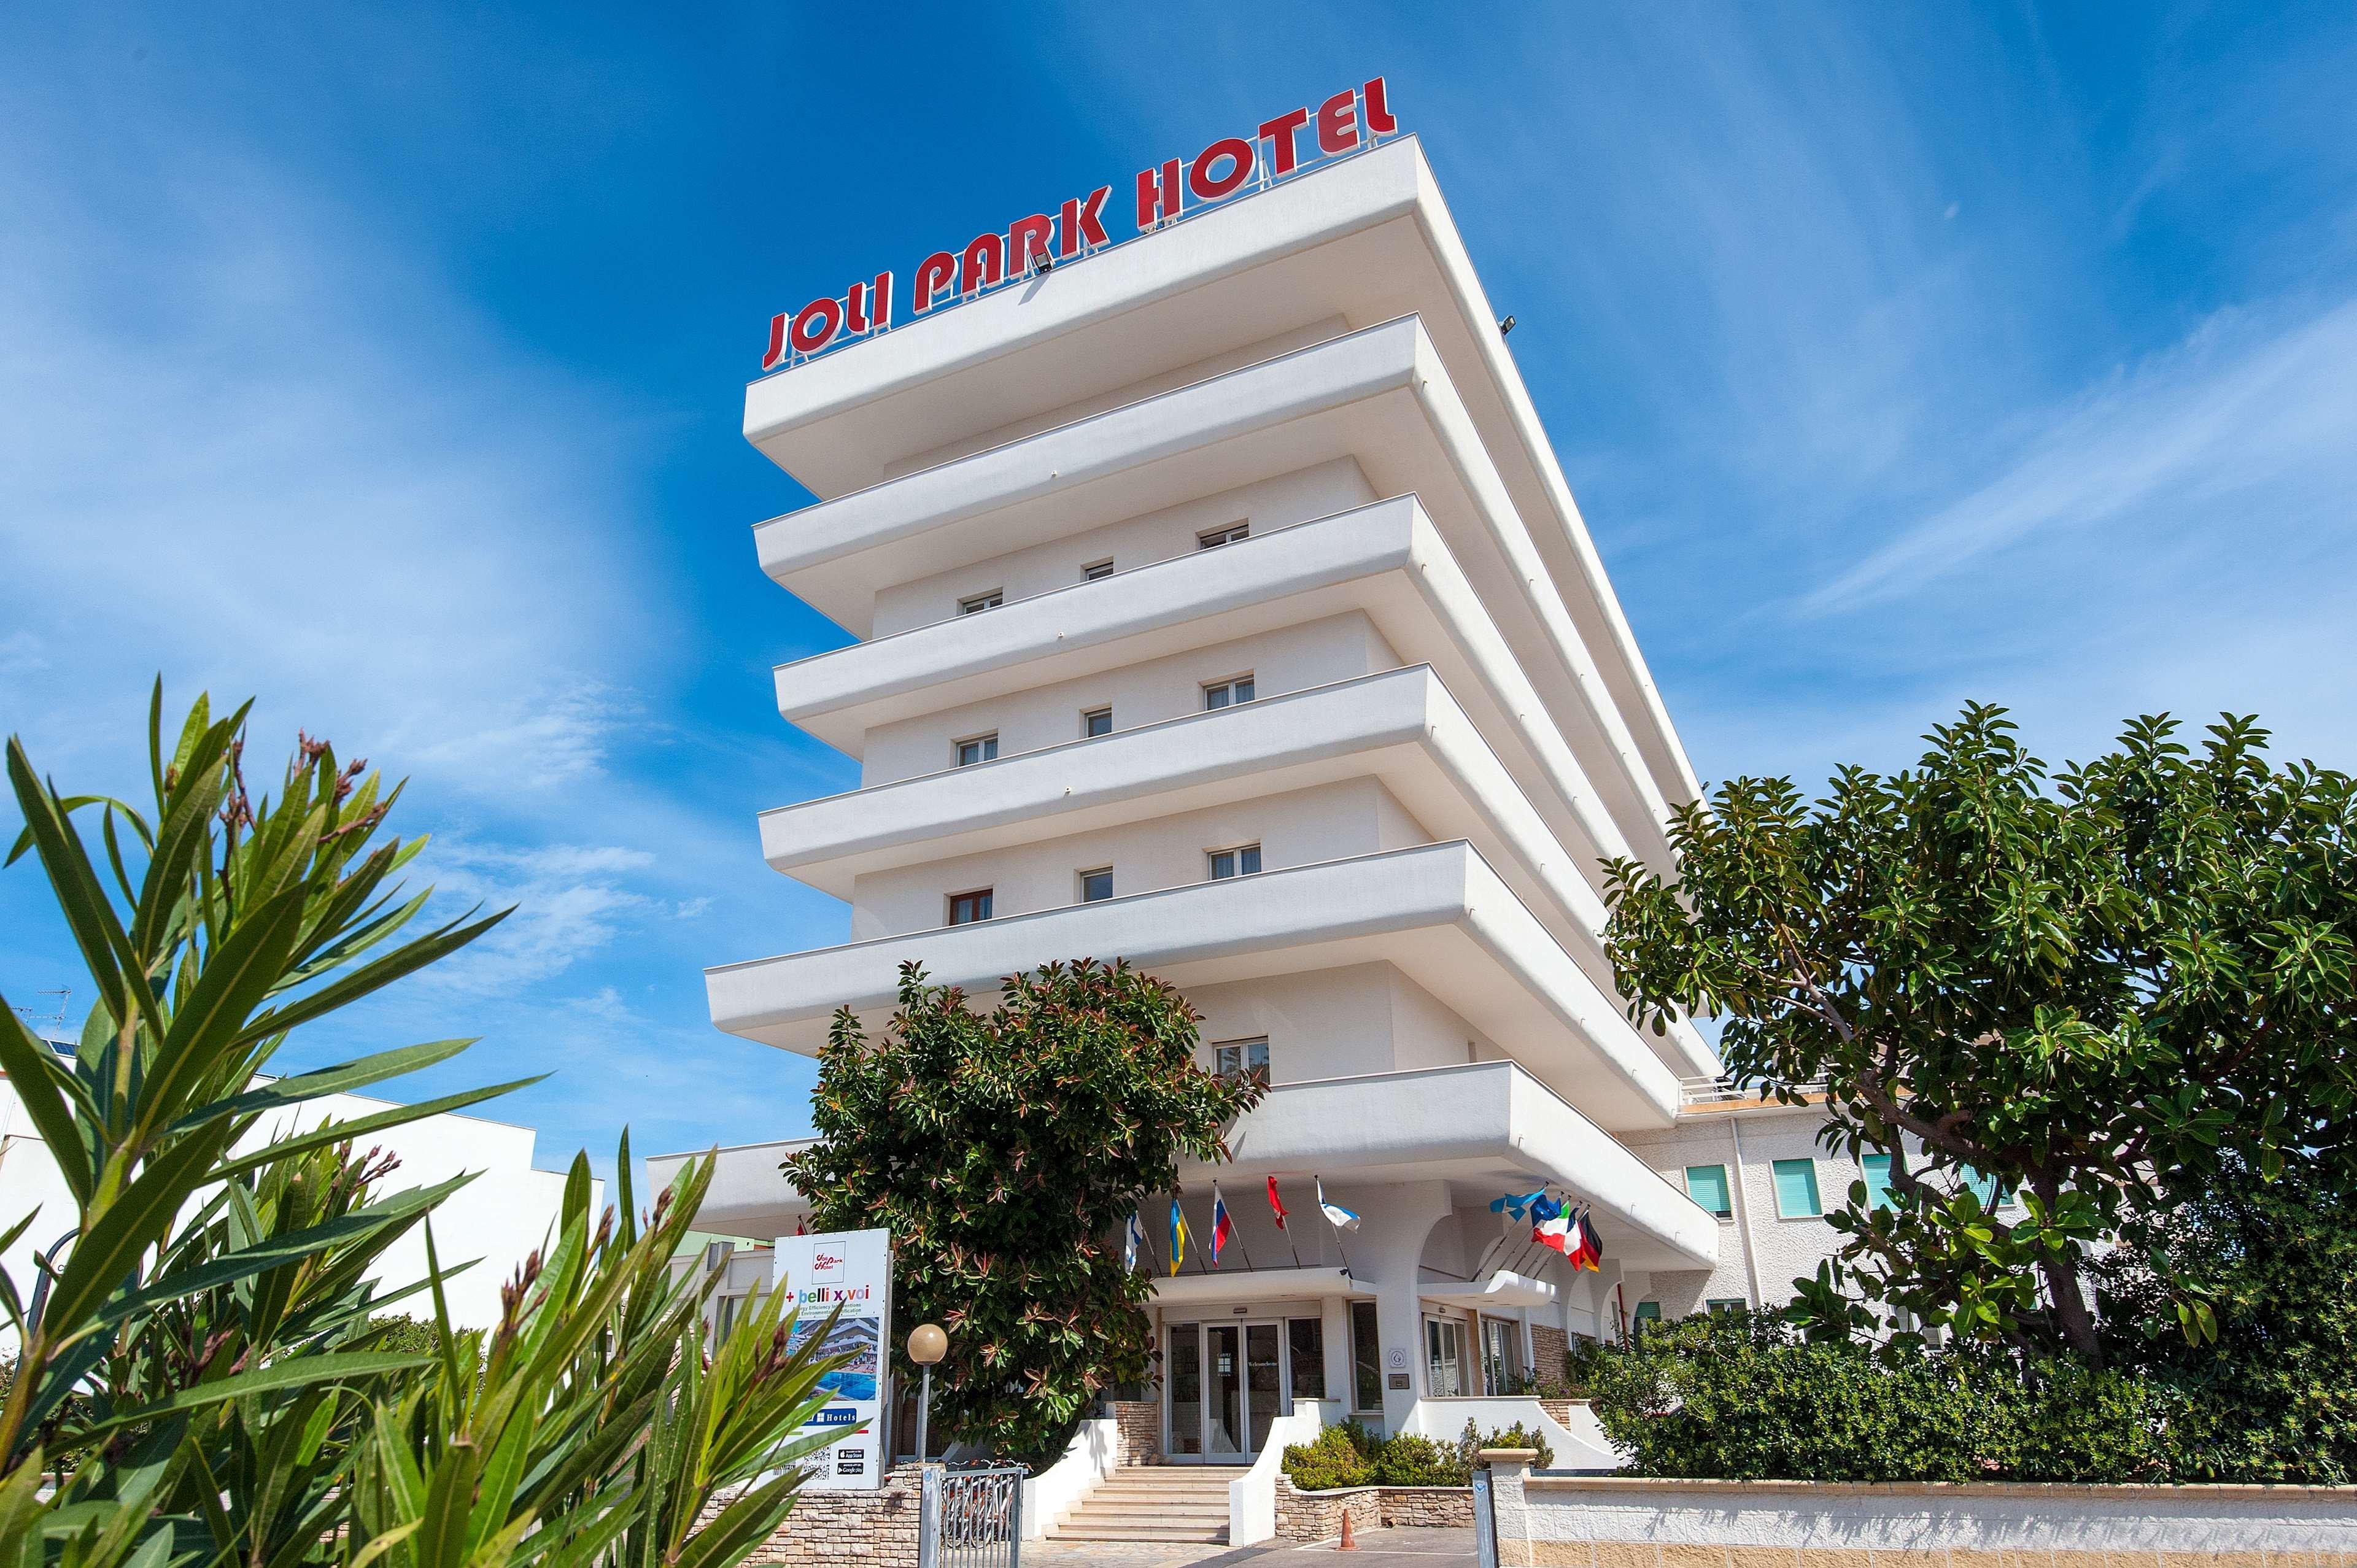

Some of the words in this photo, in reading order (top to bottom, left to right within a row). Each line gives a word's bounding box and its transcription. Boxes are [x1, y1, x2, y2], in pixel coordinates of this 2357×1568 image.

[763, 270, 894, 369] JOLI
[913, 184, 1112, 315] PARK
[1137, 76, 1398, 232] HOTEL
[799, 1288, 829, 1303] belli
[834, 1290, 843, 1301] x
[848, 1284, 869, 1300] voi
